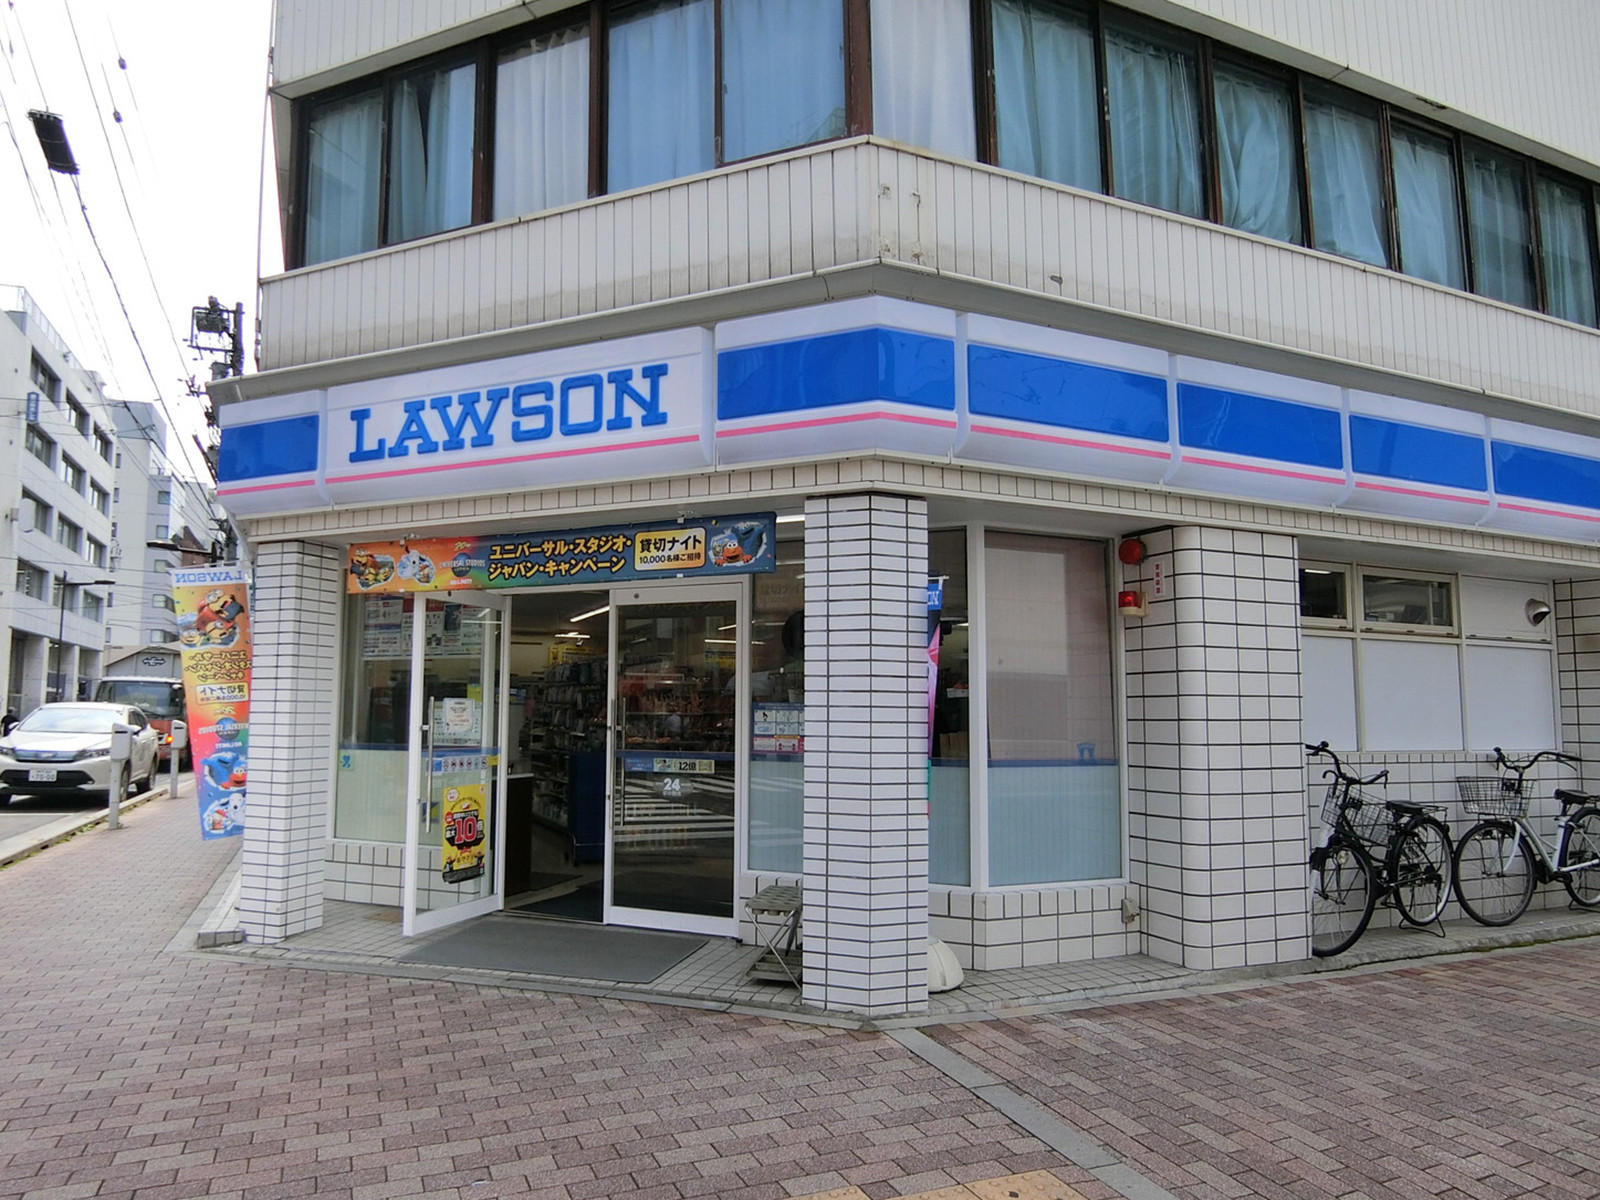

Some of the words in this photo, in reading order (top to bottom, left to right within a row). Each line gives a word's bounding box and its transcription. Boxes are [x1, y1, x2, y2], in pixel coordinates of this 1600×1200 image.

[349, 363, 668, 463] LAWSON
[489, 535, 632, 560] ユニバーサル・スタジオ・
[639, 535, 702, 553] 貸切ナイト
[488, 556, 626, 580] ジャパン・キャンペーン
[639, 552, 701, 564] 10,000名様ご招待
[663, 778, 681, 791] 24
